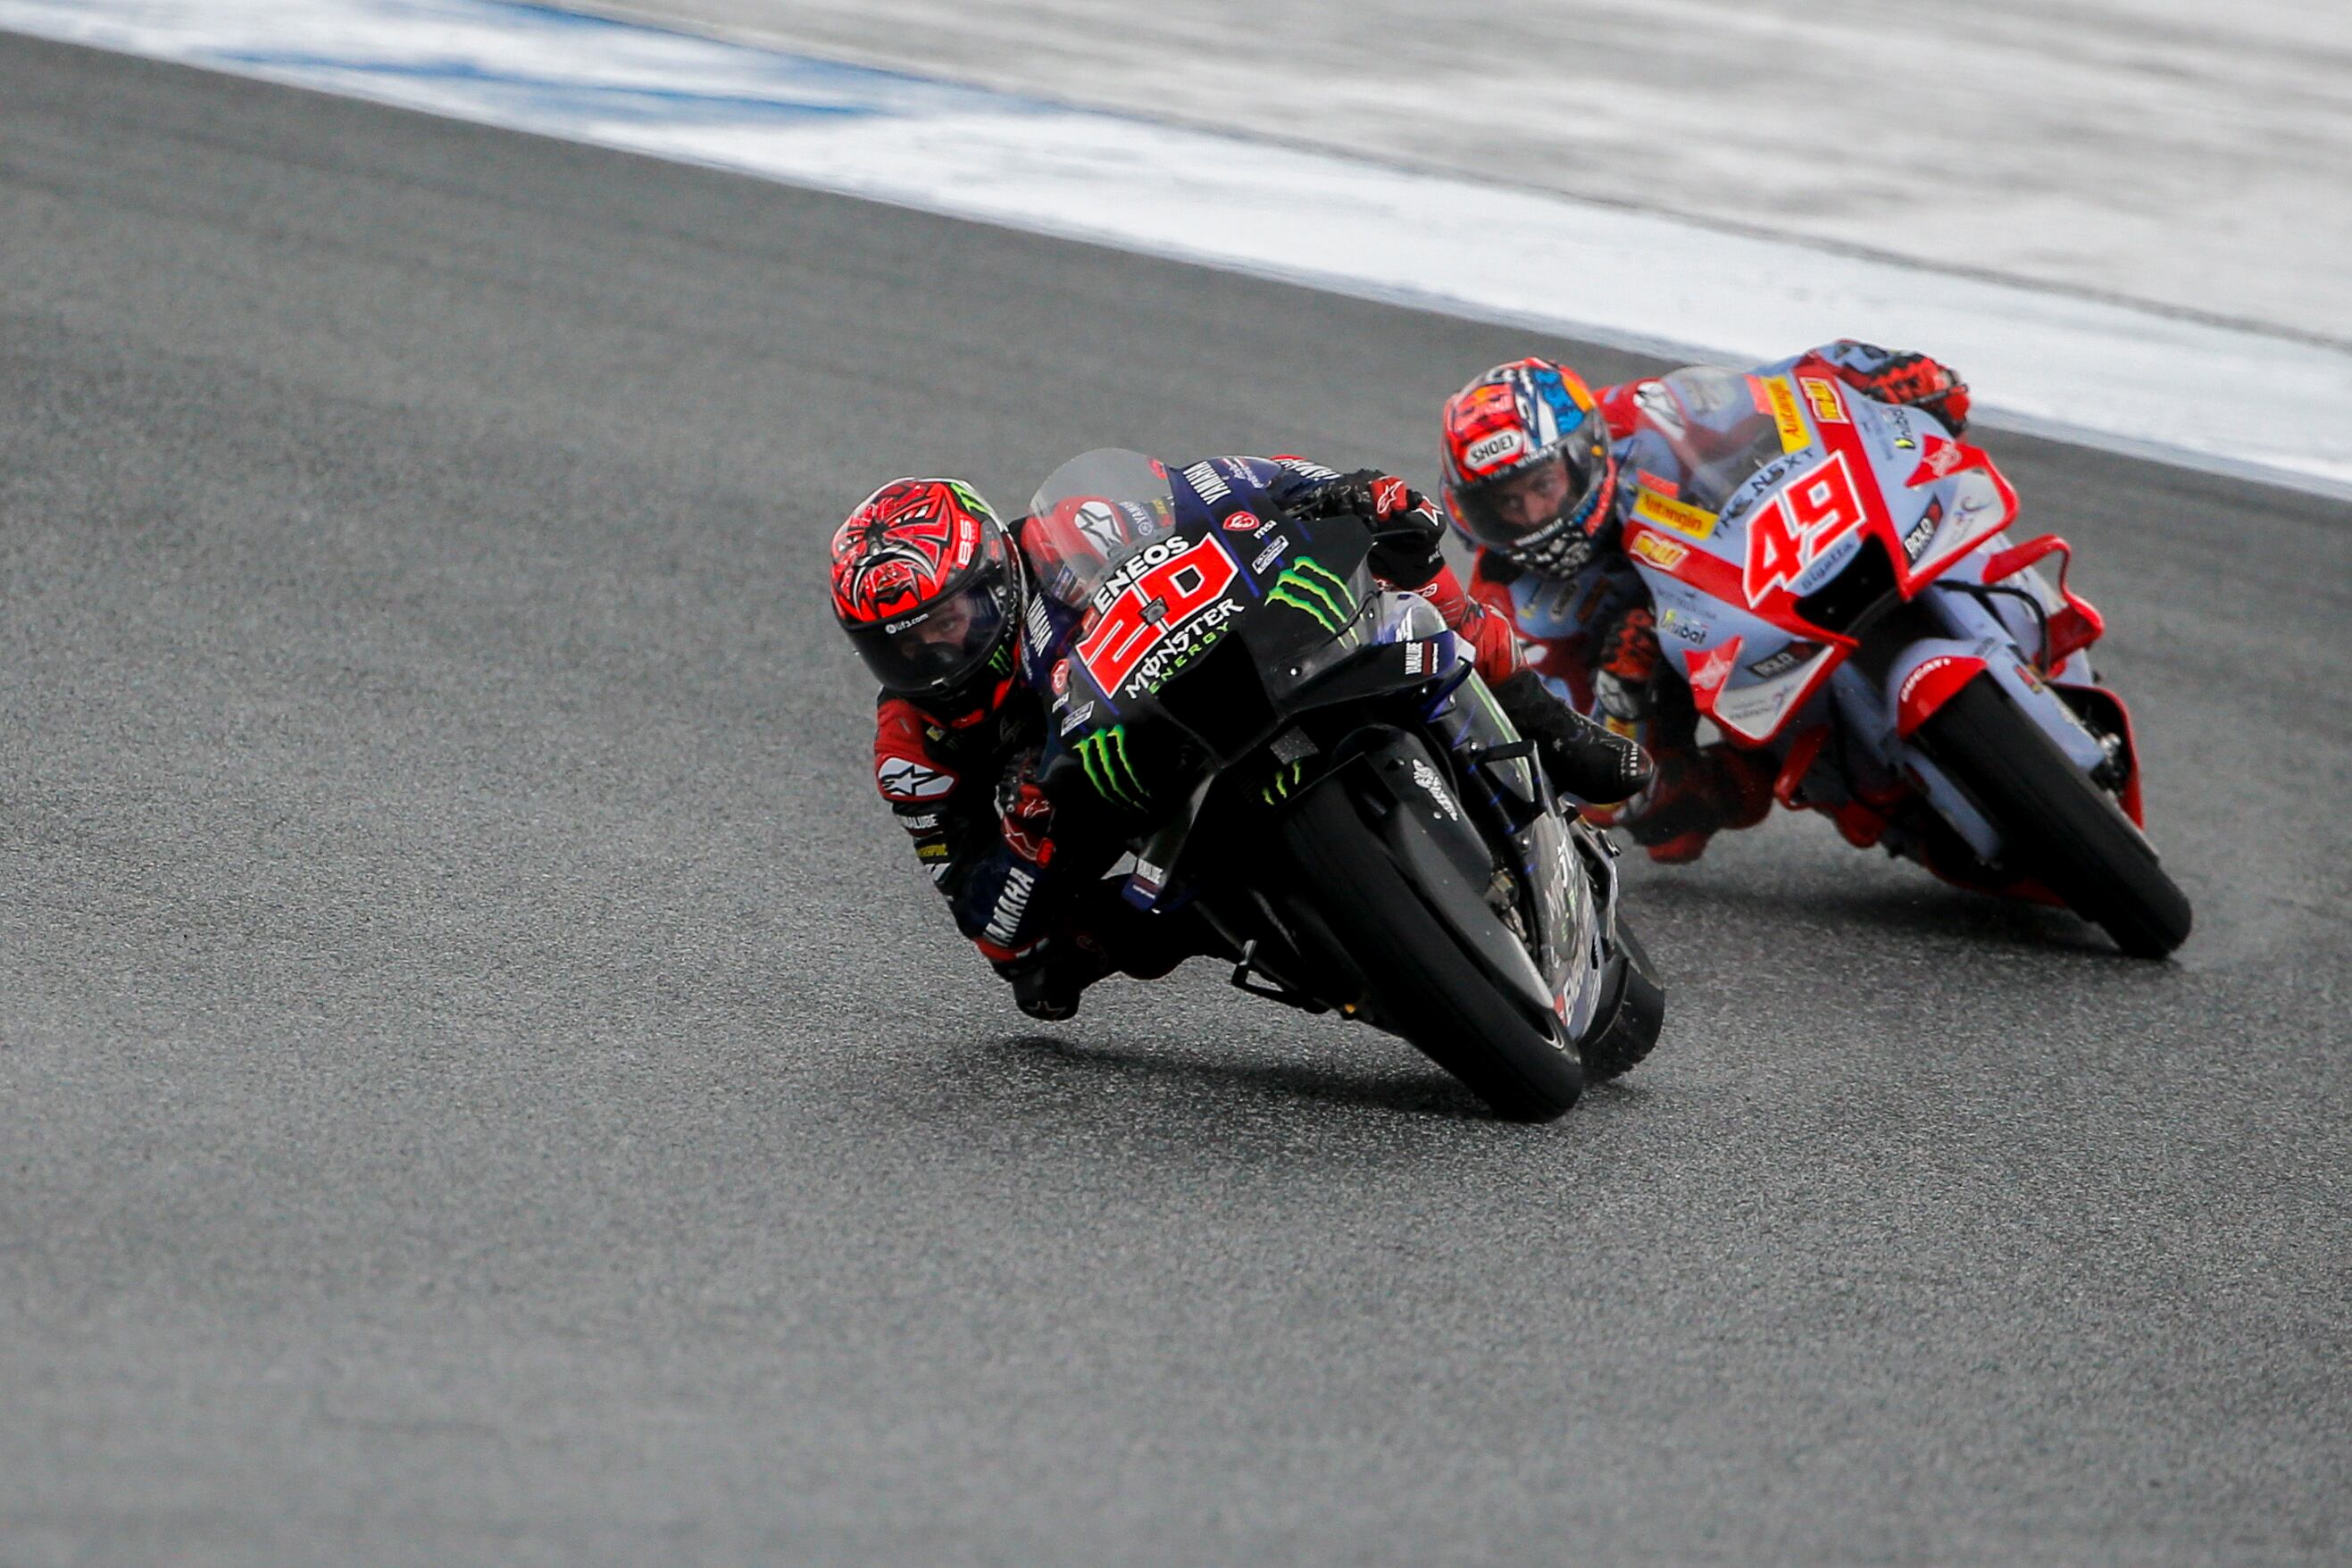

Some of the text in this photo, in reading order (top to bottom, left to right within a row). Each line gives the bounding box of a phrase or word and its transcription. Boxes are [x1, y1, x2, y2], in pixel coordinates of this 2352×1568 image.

[1182, 460, 1231, 506] YAMAHA
[1470, 434, 1514, 463] SHOEI
[1742, 449, 1867, 610] 49
[1092, 535, 1190, 614] ENEOS
[1026, 592, 1053, 657] YAMAHA
[1075, 532, 1239, 699] 20
[1148, 621, 1230, 694] ENERGY
